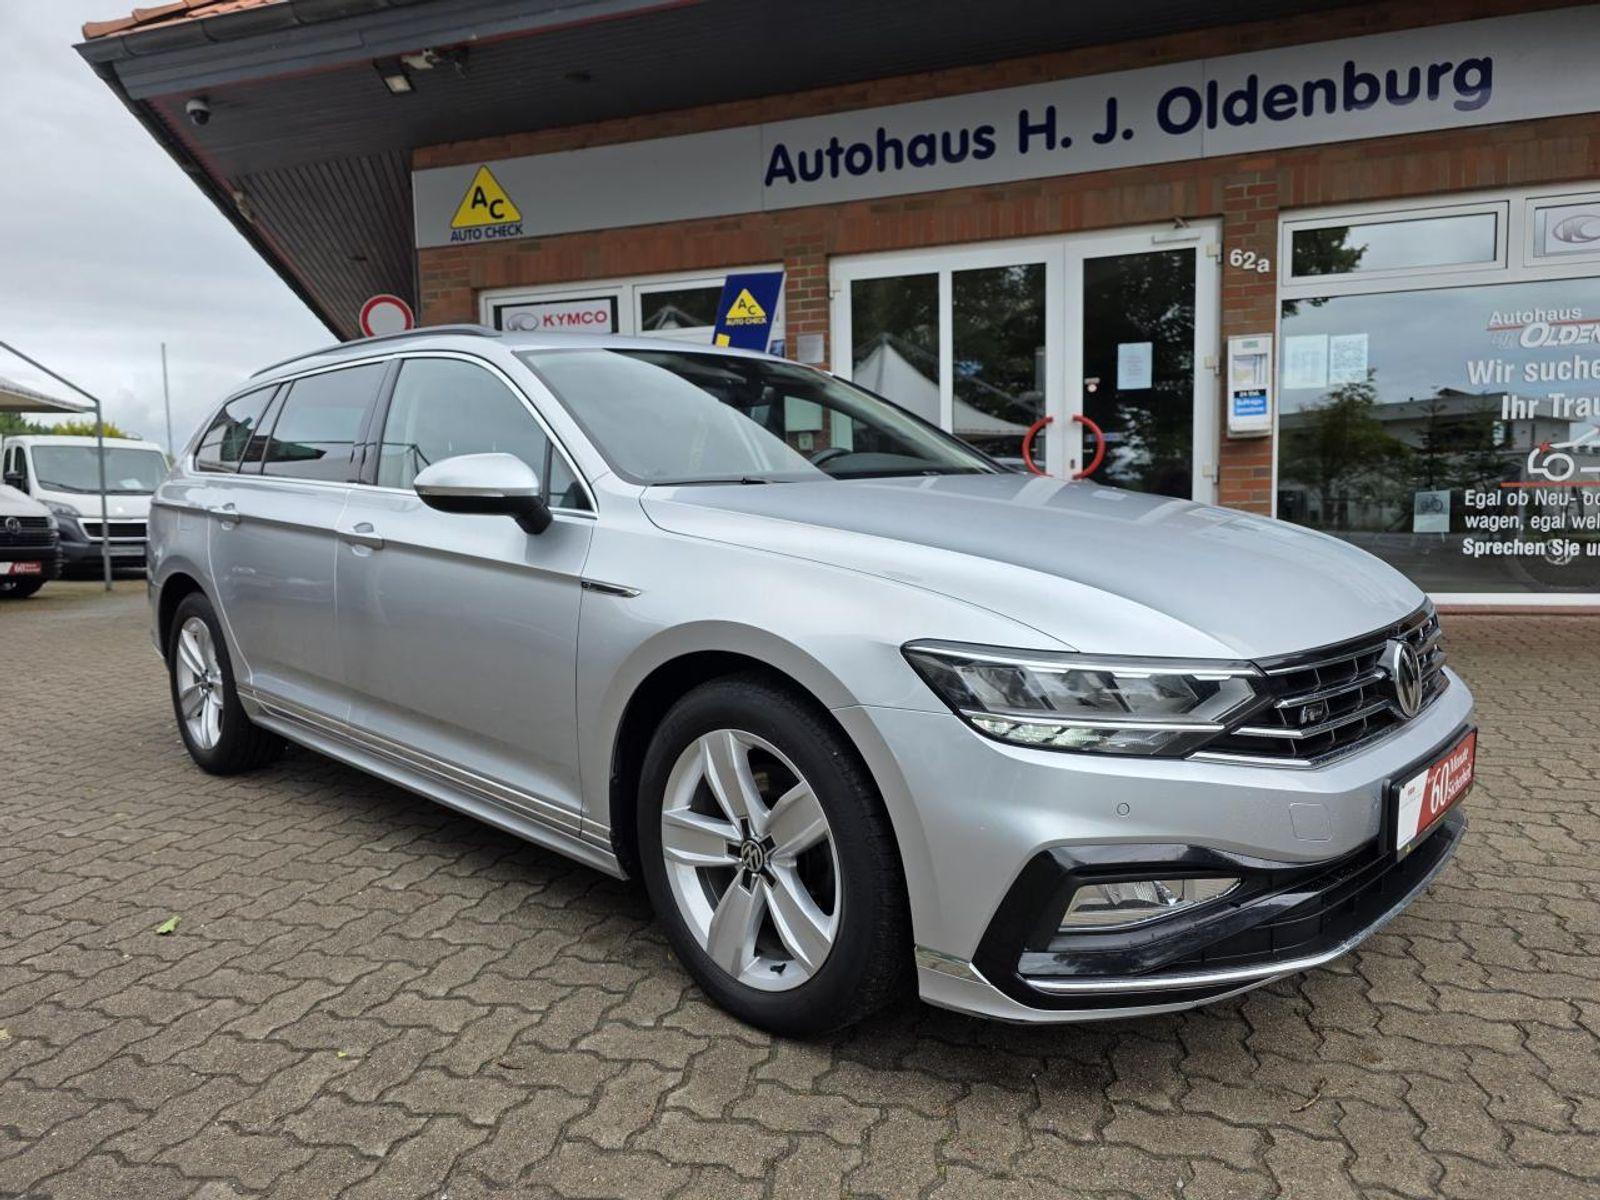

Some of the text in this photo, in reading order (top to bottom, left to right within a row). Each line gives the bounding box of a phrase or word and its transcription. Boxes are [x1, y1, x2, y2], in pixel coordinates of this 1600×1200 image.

[764, 55, 1494, 187] Autohaus H. J. Oldenburg
[450, 224, 524, 242] AUTO CHECK
[1230, 249, 1270, 273] 62a
[542, 310, 608, 327] KYMCO
[1489, 308, 1582, 326] Autohaus
[1467, 359, 1515, 385] Wir
[1501, 394, 1539, 420] Ihr
[1464, 489, 1501, 508] Egal
[1507, 489, 1529, 506] ob
[1534, 489, 1577, 506] Neu-
[1465, 514, 1524, 532] wagen,
[1530, 512, 1566, 532] egal
[1462, 538, 1545, 558] Sprechen
[1551, 538, 1580, 556] Sie
[1430, 762, 1449, 814] 60
